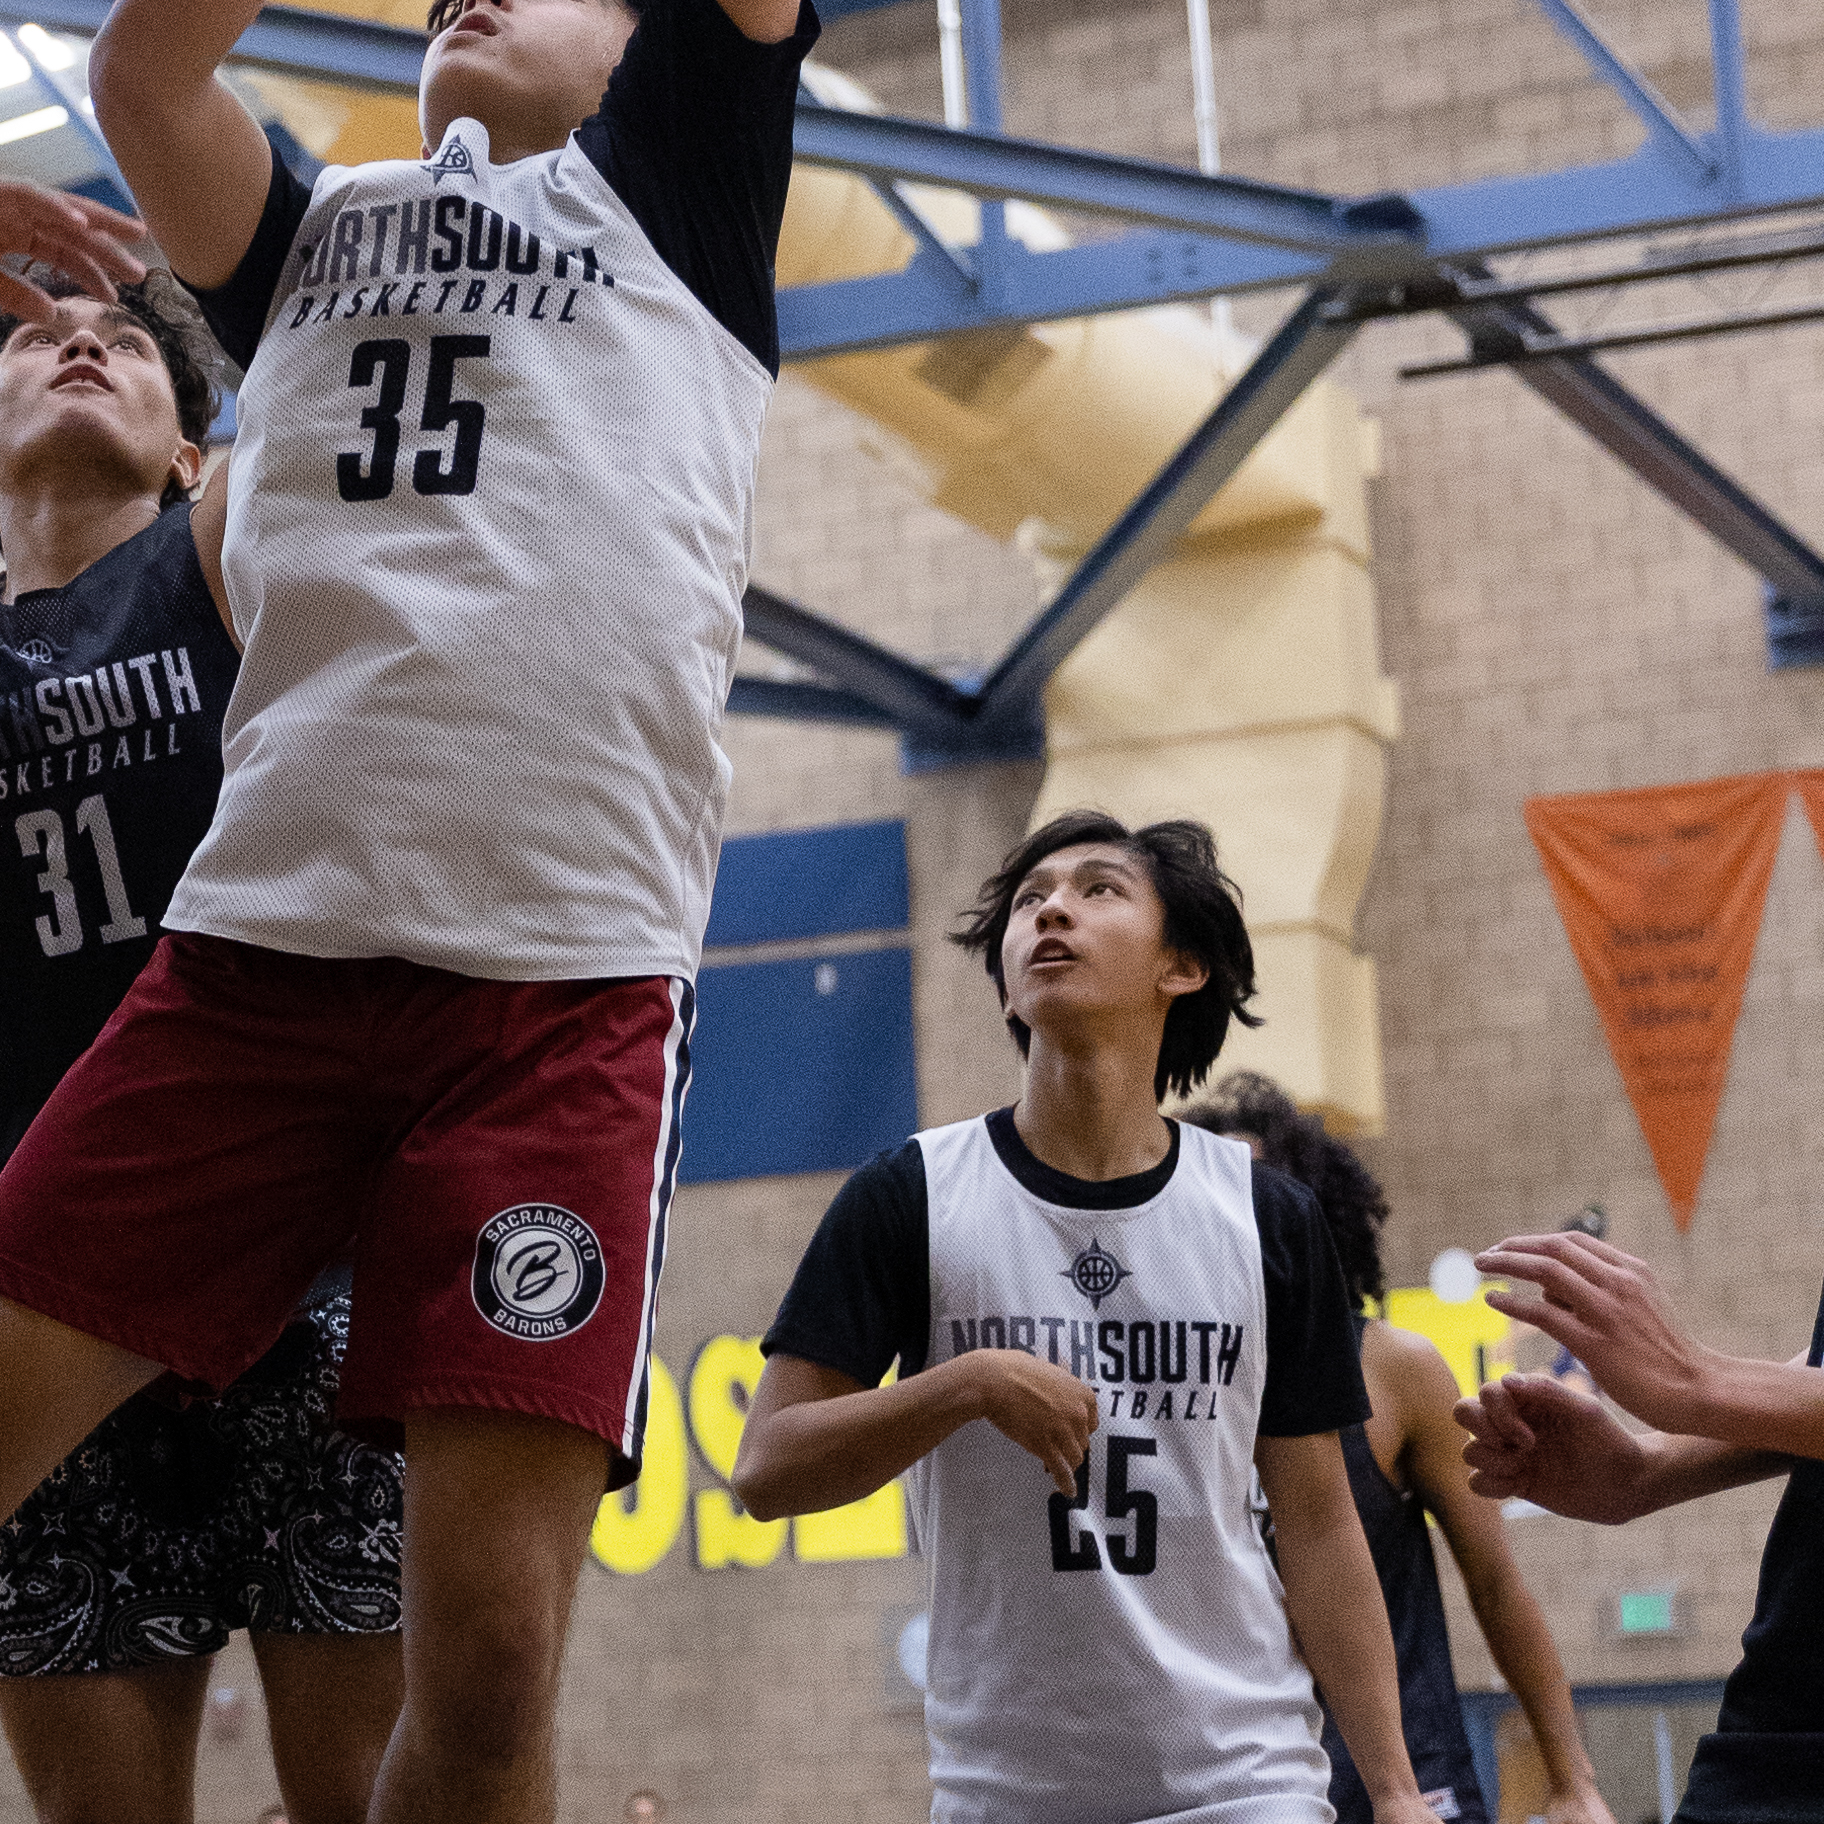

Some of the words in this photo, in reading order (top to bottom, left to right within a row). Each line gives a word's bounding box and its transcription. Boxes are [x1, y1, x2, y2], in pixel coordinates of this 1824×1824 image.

[289, 279, 579, 330] BASKETBALL
[335, 334, 491, 503] 35
[14, 793, 148, 958] 31
[485, 1210, 597, 1261] SACRAMENTO
[493, 1308, 567, 1336] BARONS
